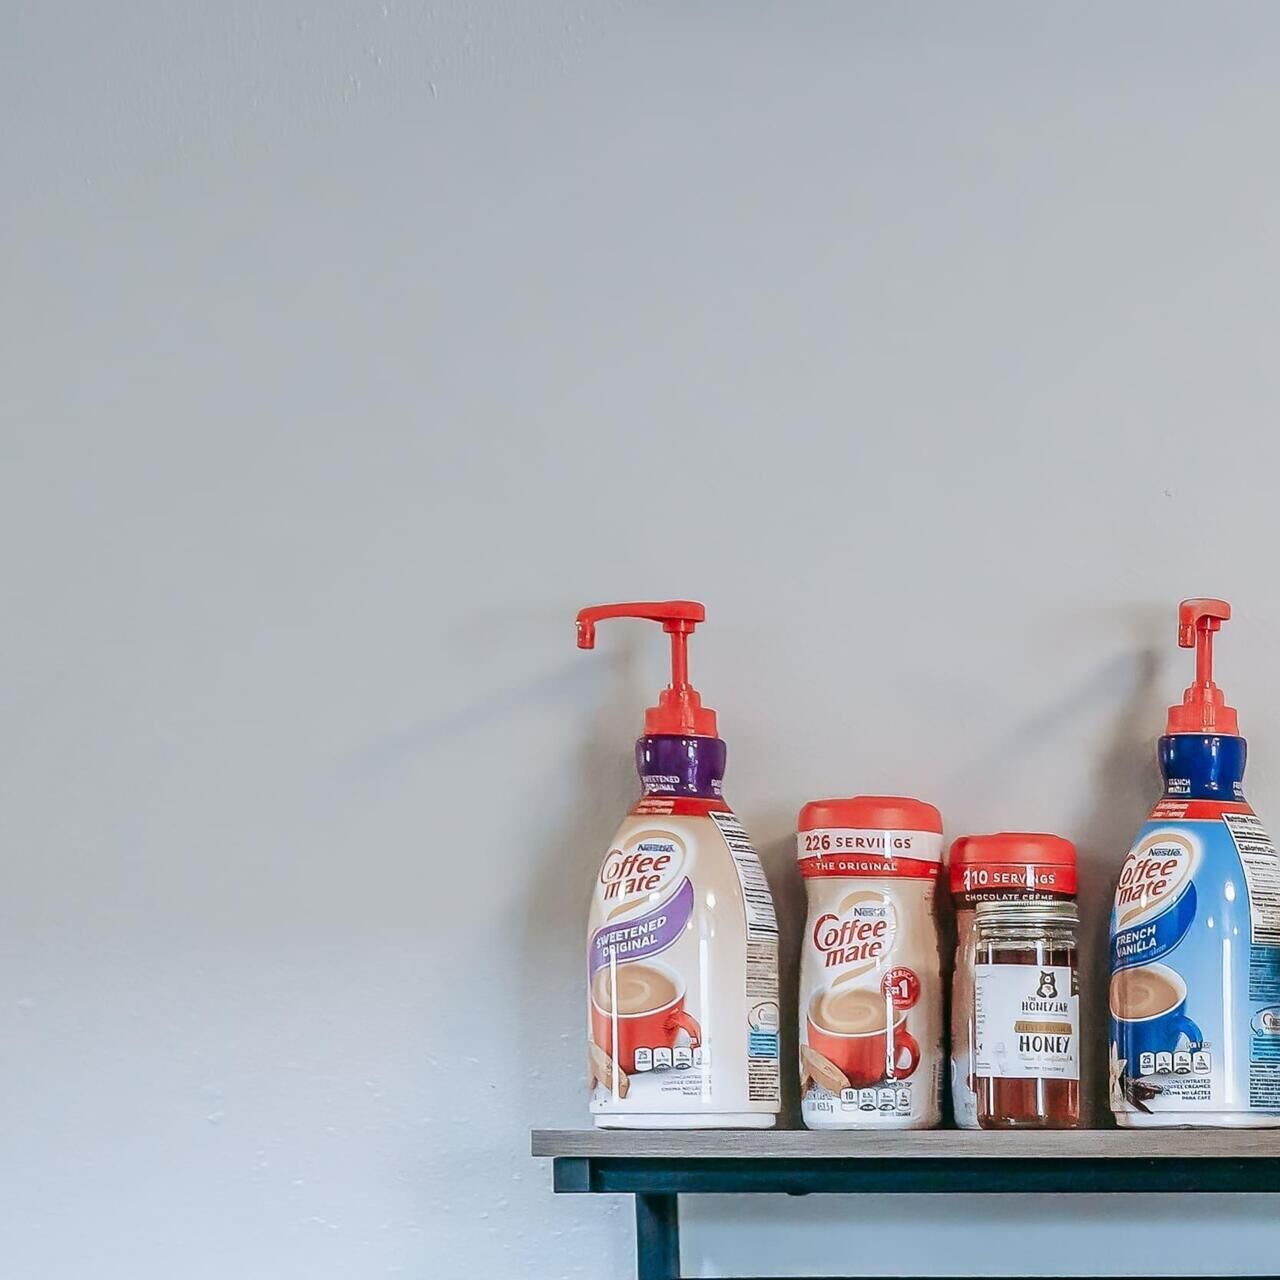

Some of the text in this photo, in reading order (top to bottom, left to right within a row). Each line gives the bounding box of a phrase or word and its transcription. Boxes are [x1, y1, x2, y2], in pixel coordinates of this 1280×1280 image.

[805, 834, 831, 851] 226
[600, 848, 671, 884] Coffee
[816, 861, 898, 871] THE ORIGINAL
[1116, 853, 1178, 890] Coffee
[604, 873, 661, 901] mate
[965, 893, 1020, 901] CHOCOLATE
[1118, 879, 1167, 906] mate
[596, 916, 667, 949] SWEETENED
[813, 913, 887, 952] Coffee
[1116, 924, 1157, 947] FRENCH
[825, 941, 882, 968] mate
[1116, 938, 1157, 958] VANILLA
[1019, 1035, 1070, 1054] HONEY
